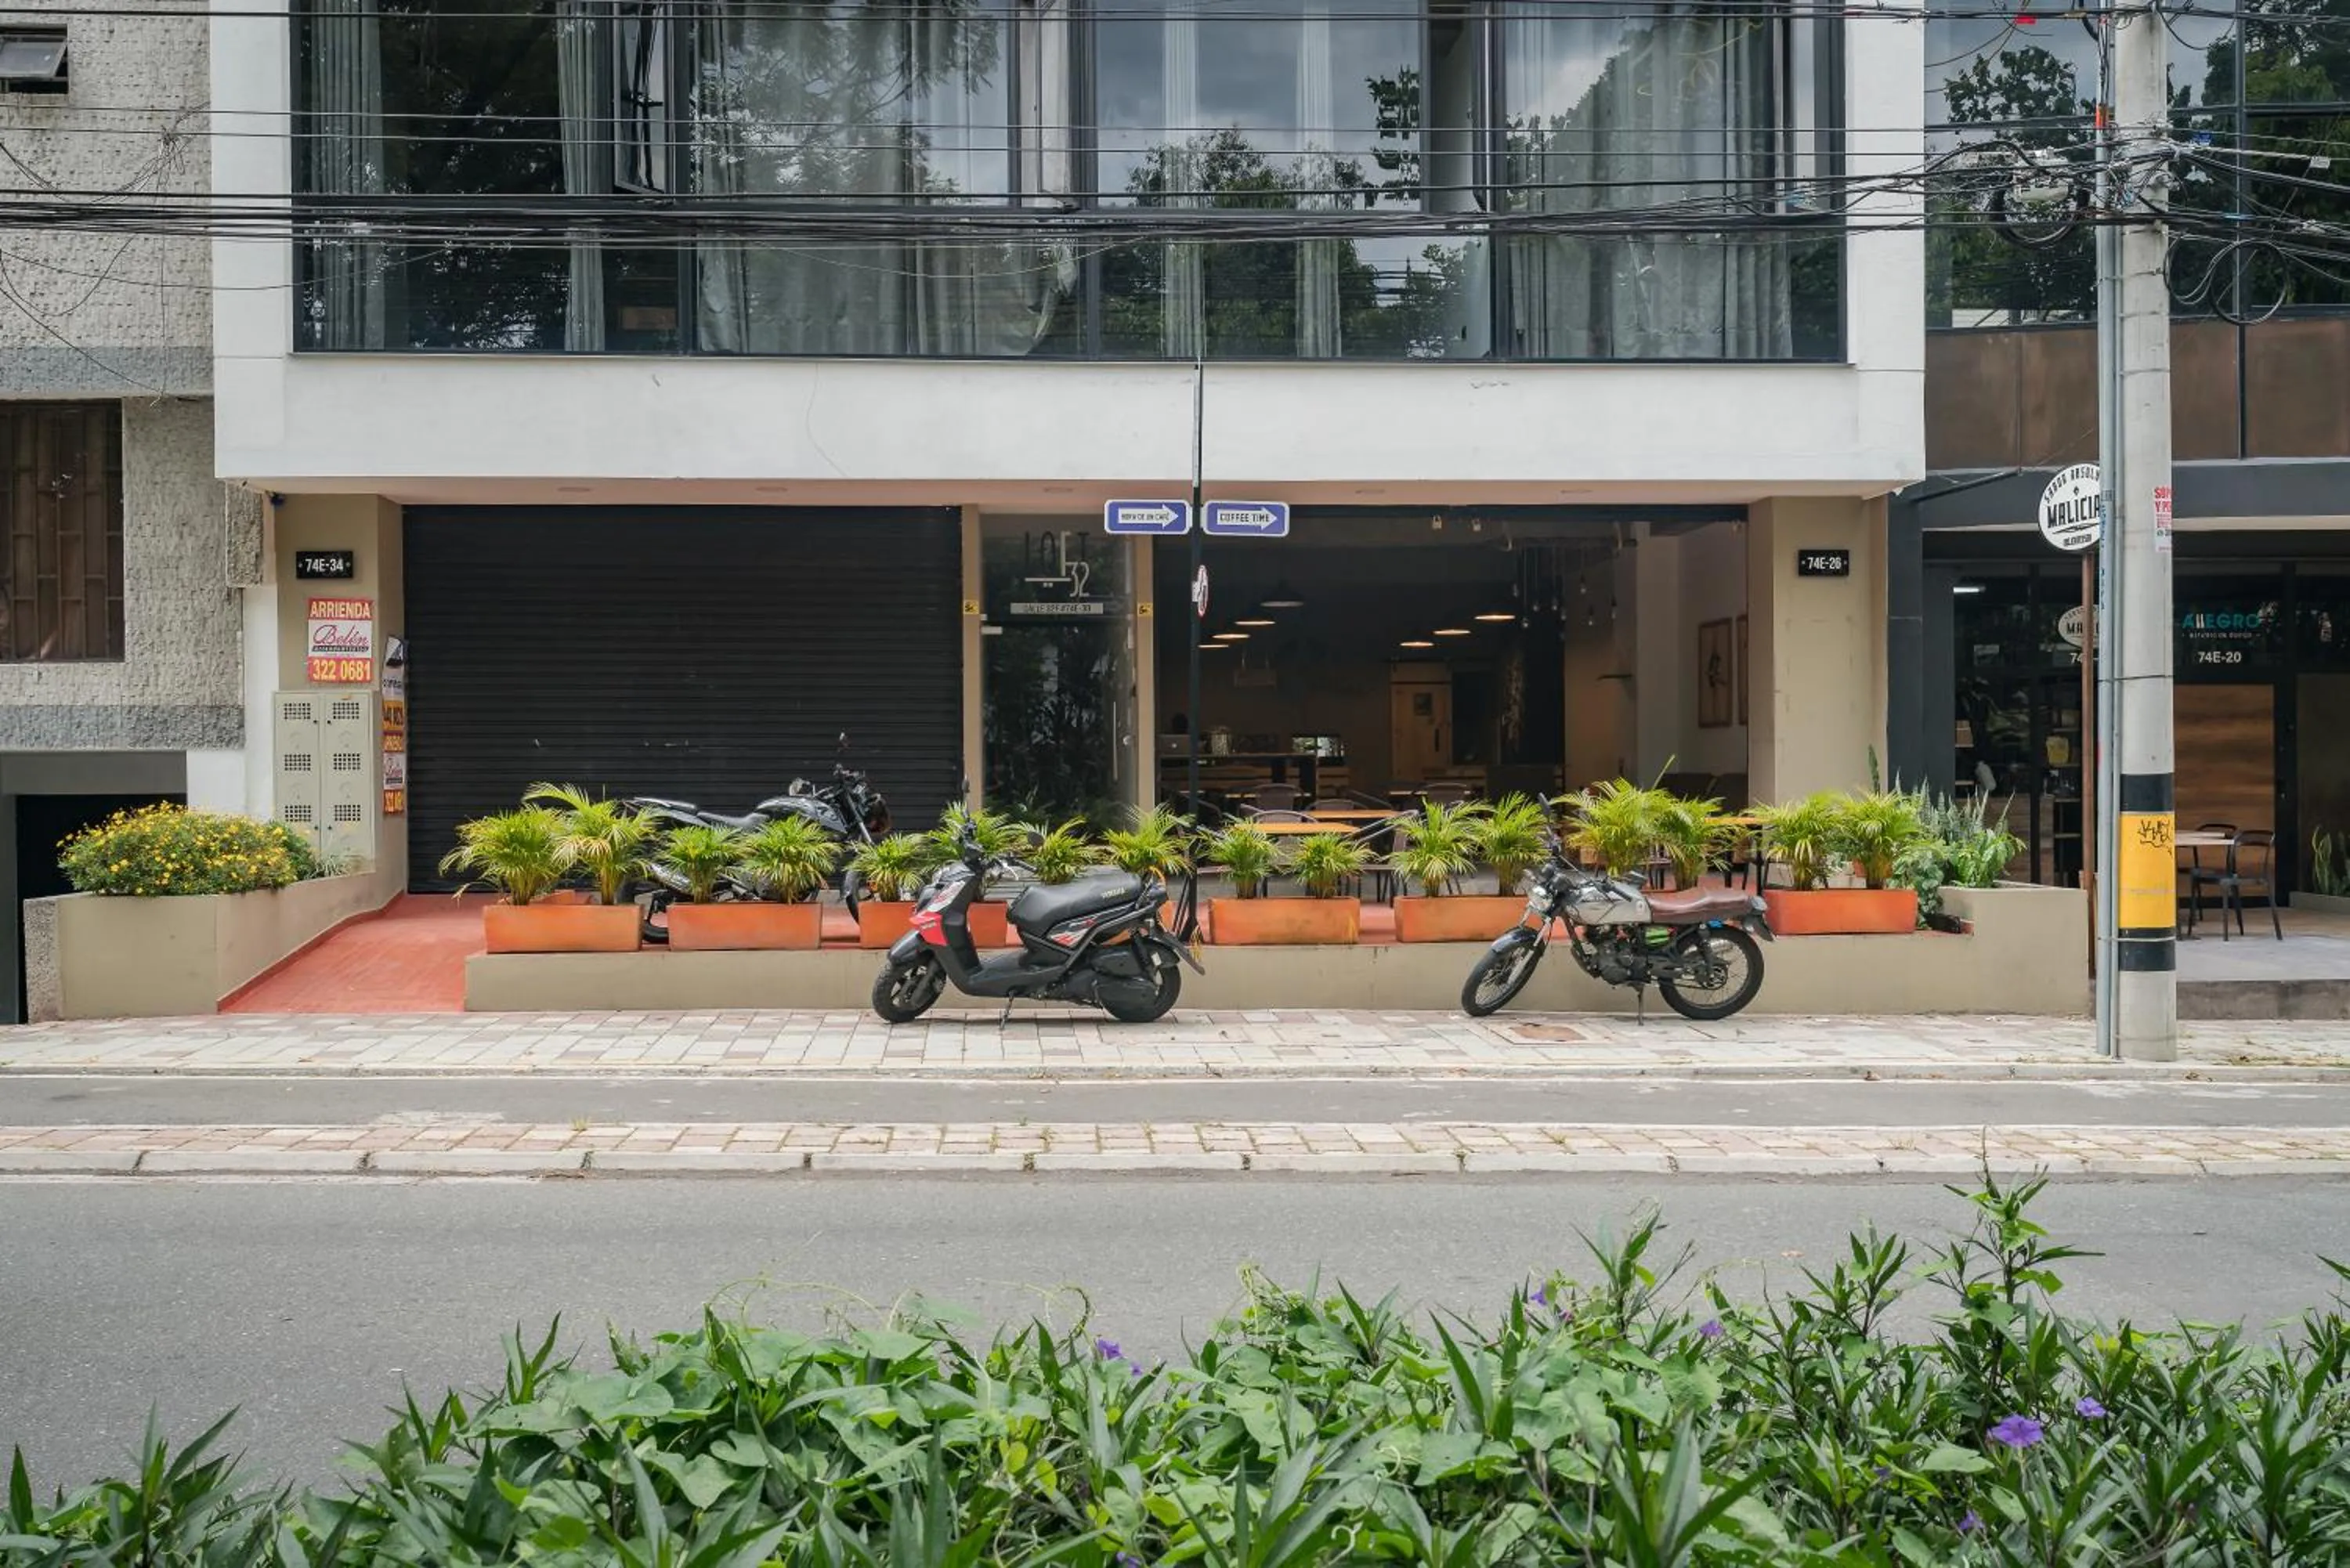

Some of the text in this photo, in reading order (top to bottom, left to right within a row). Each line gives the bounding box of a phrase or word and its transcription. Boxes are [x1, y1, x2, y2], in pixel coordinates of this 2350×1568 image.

[1253, 514, 1271, 522] TIME
[2047, 494, 2099, 529] MALICIA
[305, 558, 344, 573] 74E-34
[1806, 557, 1842, 569] 74E-26
[310, 601, 371, 618] ARRIENDA
[2197, 651, 2242, 663] 74E-20
[313, 659, 371, 681] 322 0681
